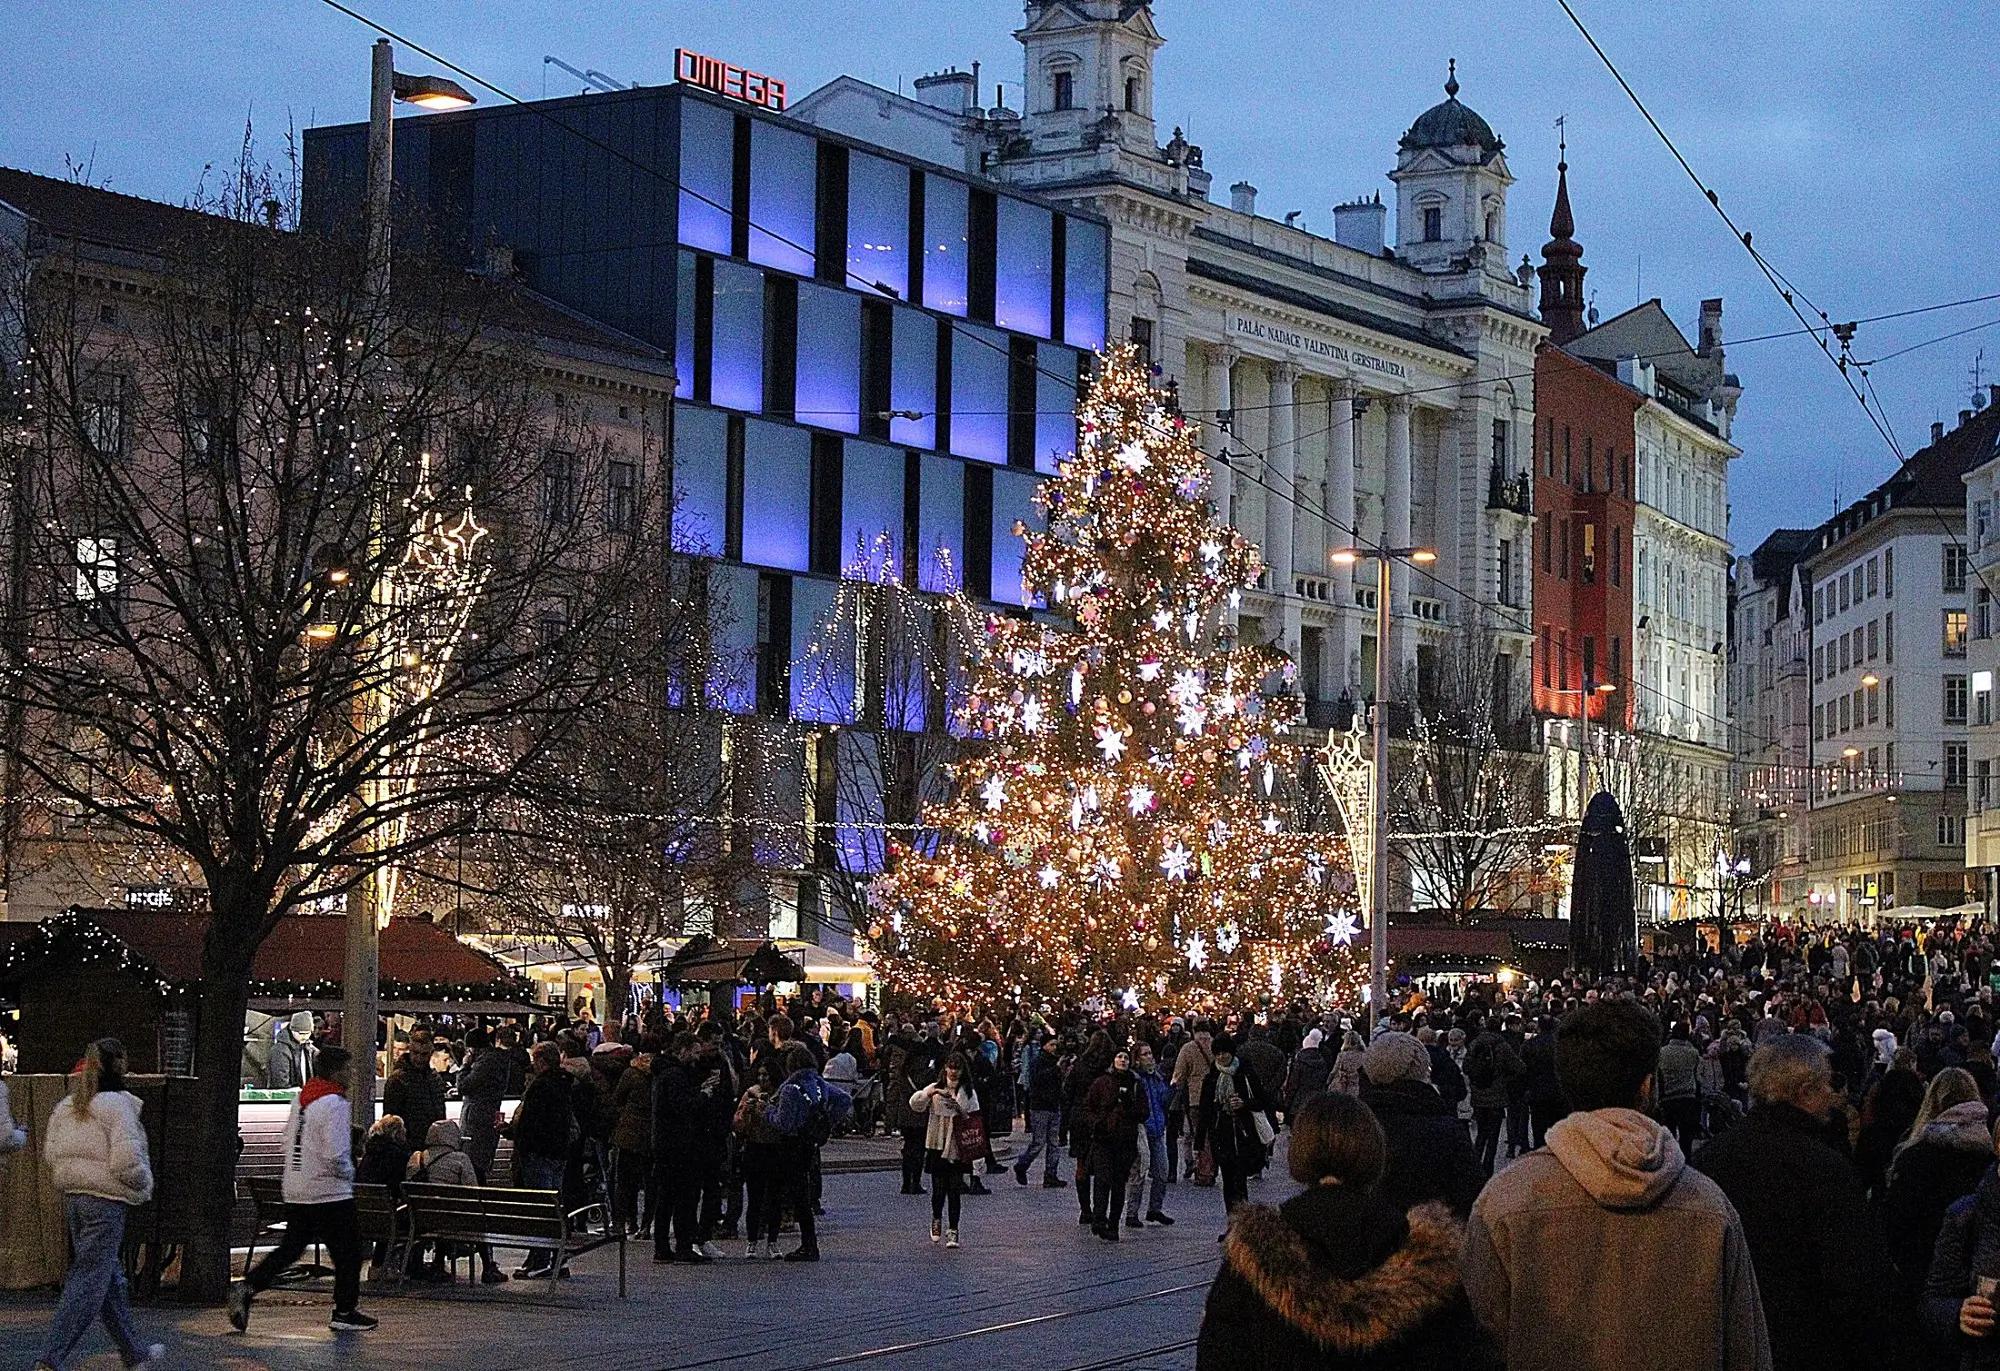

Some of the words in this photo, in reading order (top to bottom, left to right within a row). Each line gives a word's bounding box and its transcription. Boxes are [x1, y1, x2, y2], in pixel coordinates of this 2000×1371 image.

[675, 48, 787, 110] OMEGA
[1237, 317, 1266, 338] PALÁC
[1268, 327, 1301, 349] NADACE
[1304, 338, 1349, 362] VALENTINA
[1352, 352, 1406, 379] GERSTBAUERA
